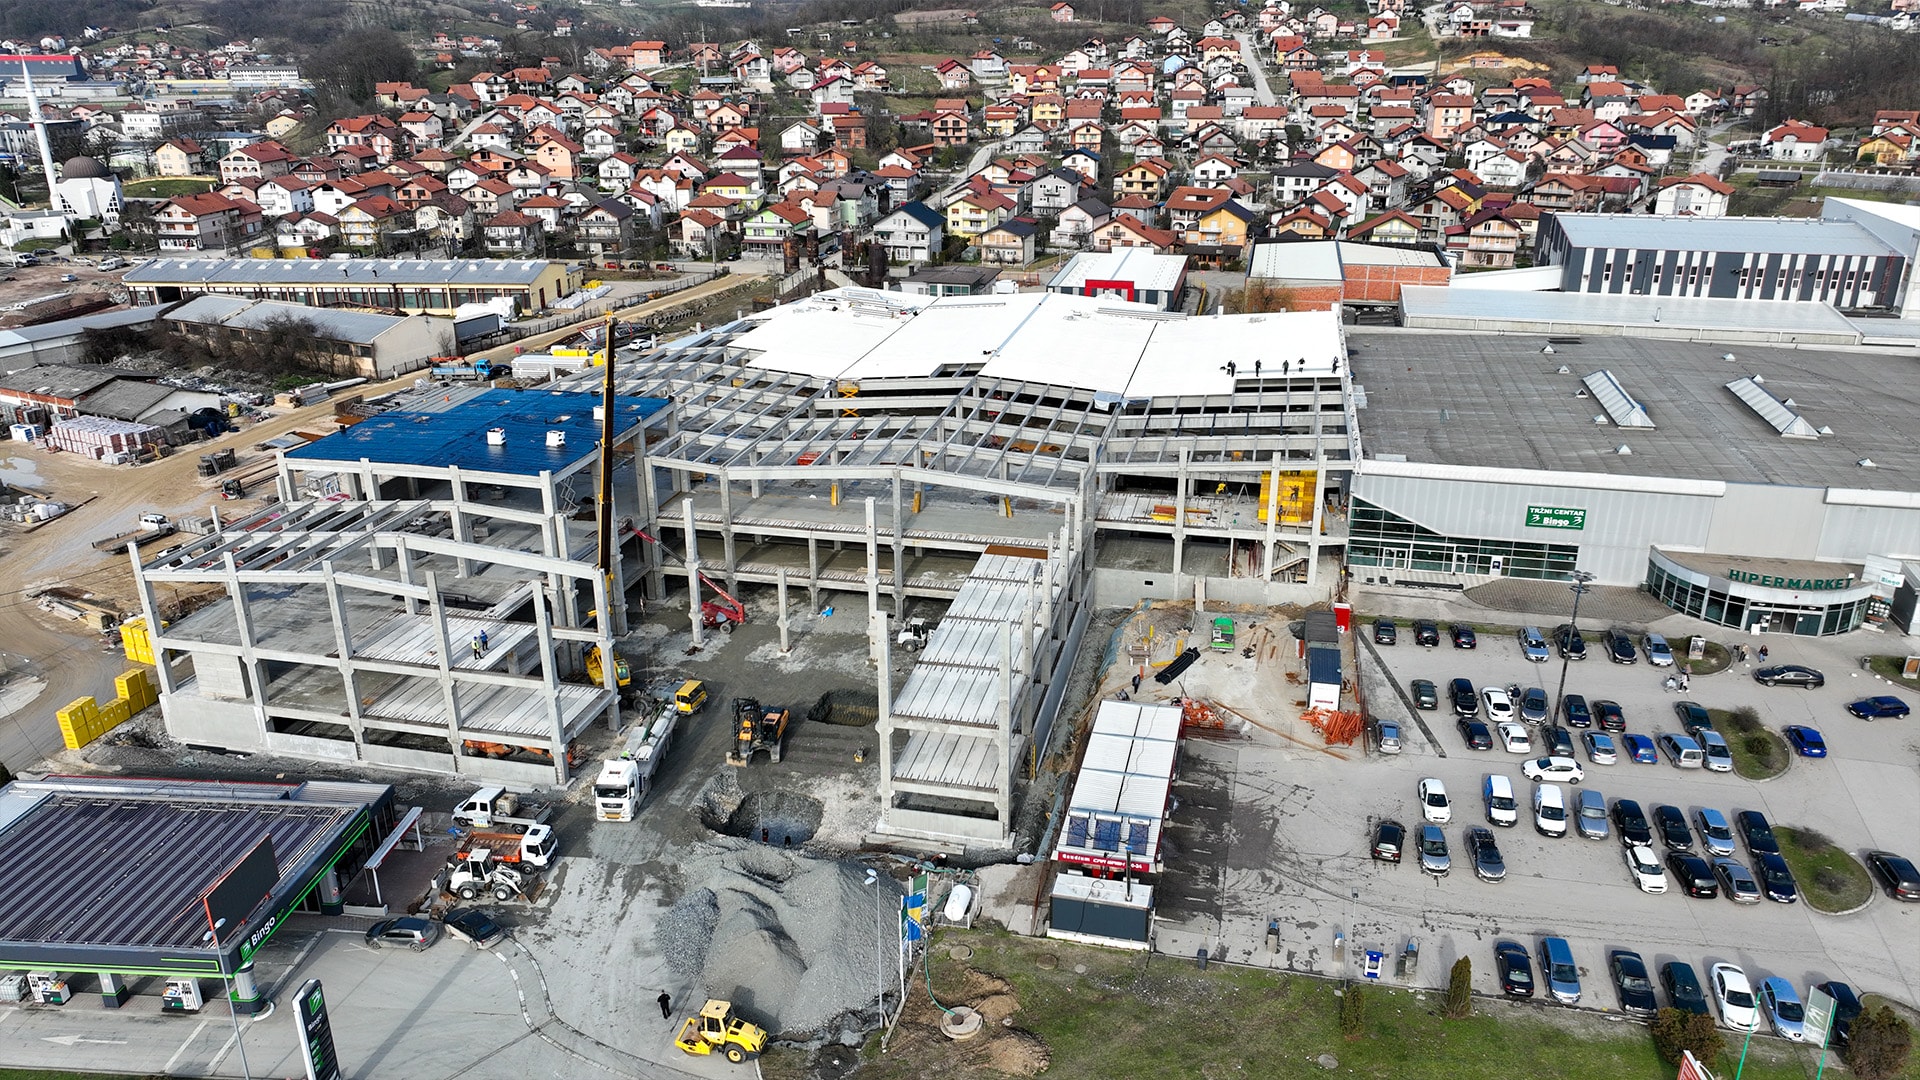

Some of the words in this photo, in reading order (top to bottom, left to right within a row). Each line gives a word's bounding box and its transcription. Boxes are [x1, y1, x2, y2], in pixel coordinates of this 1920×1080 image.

[1543, 517, 1569, 526] Bingo
[1729, 569, 1854, 591] HIPERMARKET
[251, 916, 276, 946] Bingo
